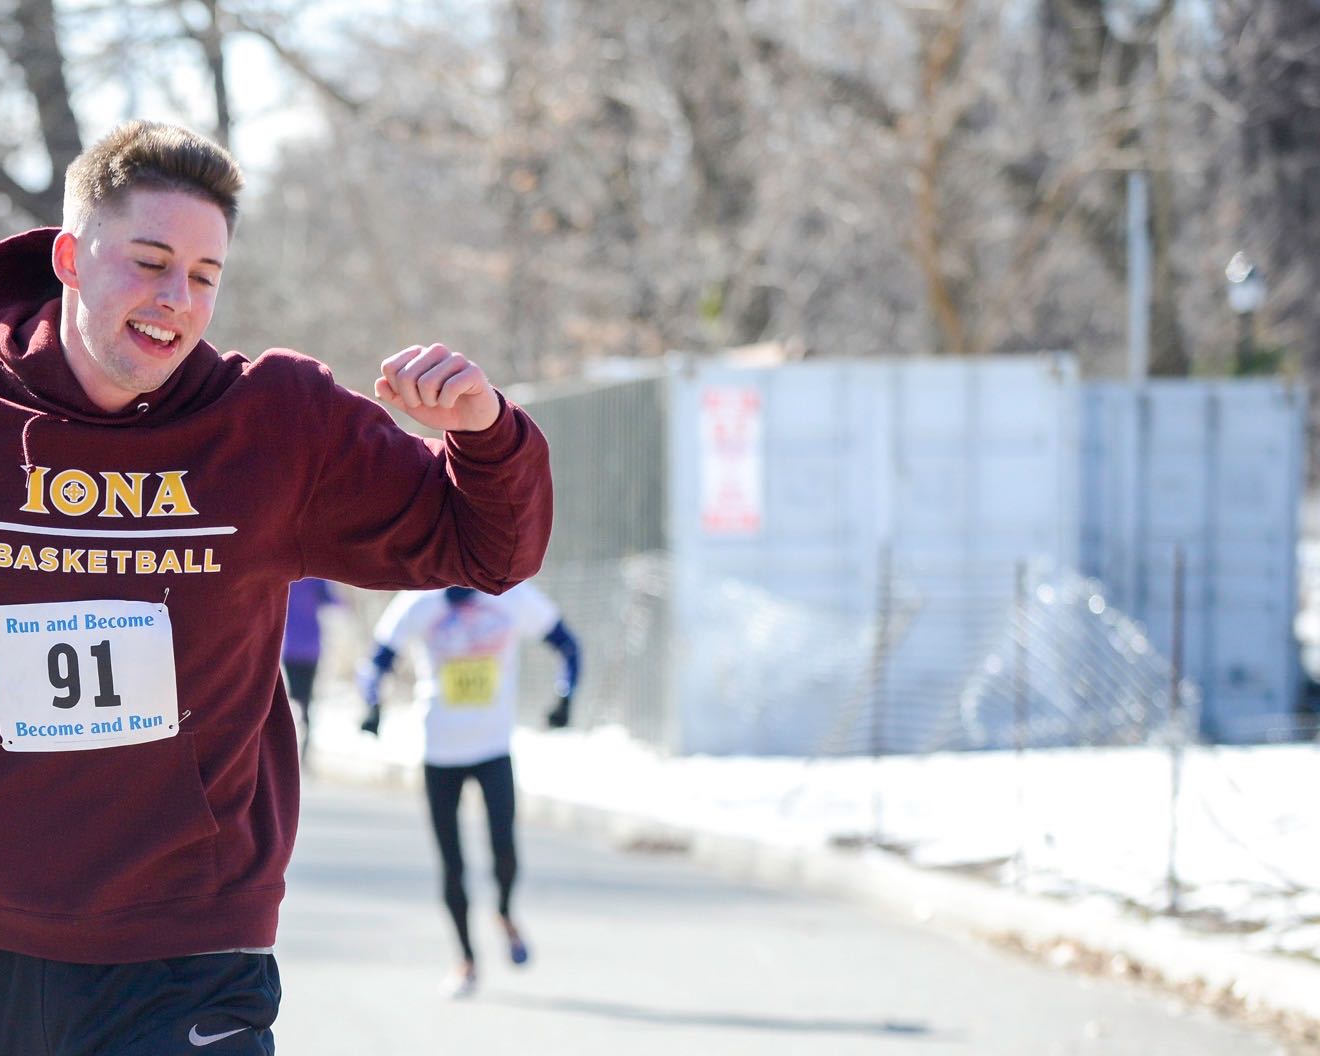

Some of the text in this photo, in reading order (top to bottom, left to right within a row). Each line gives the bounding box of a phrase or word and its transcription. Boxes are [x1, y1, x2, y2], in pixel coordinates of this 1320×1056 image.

[19, 464, 199, 518] IONA
[6, 613, 154, 634] Run and Become
[47, 639, 122, 709] 91
[15, 713, 163, 738] Become and Run
